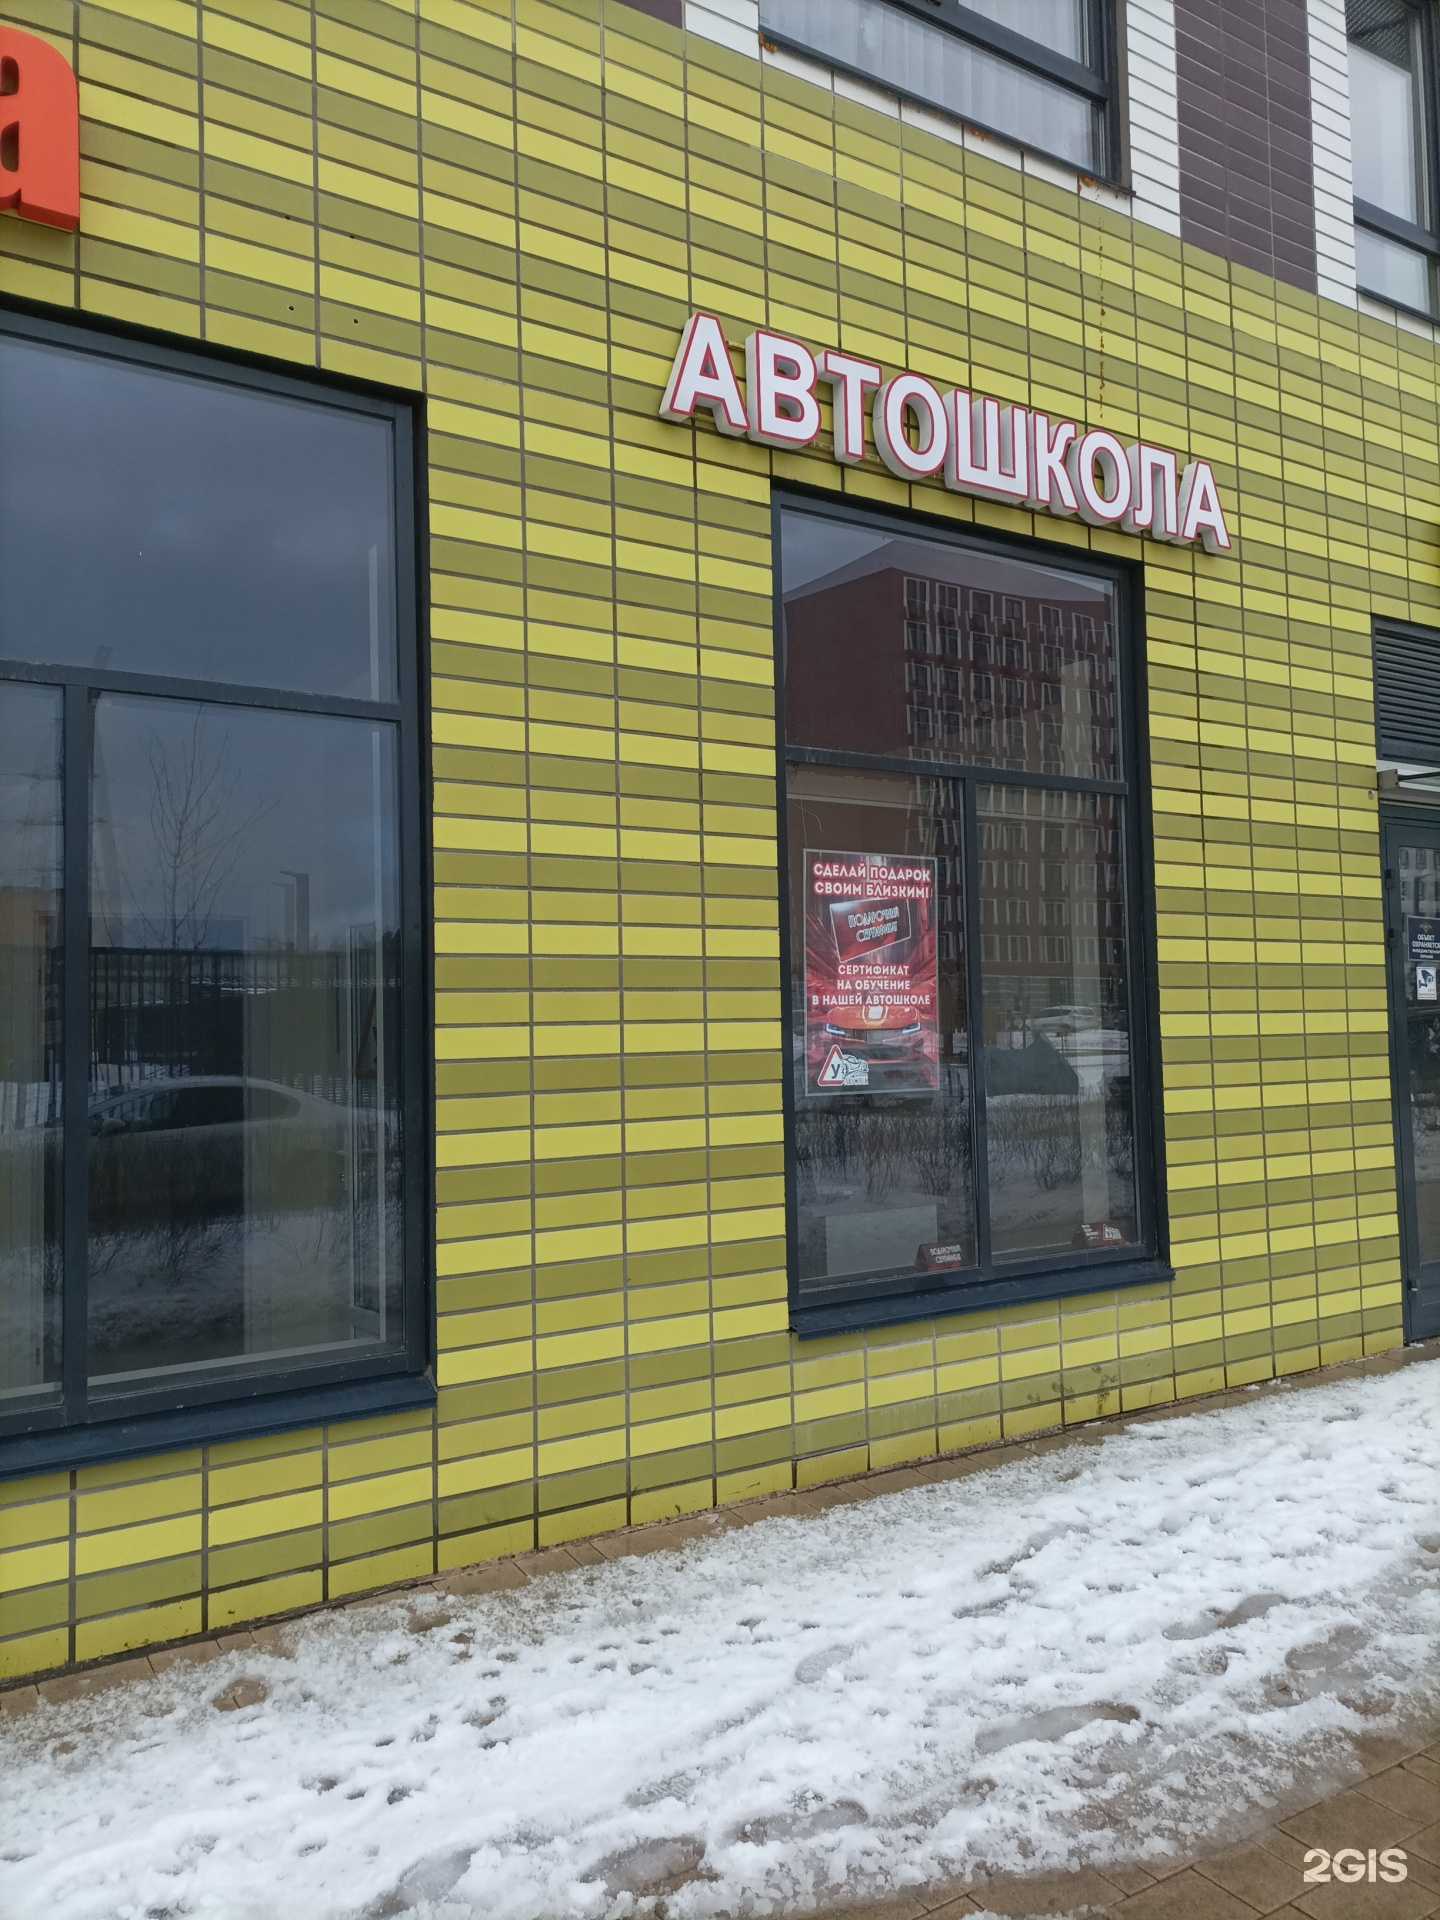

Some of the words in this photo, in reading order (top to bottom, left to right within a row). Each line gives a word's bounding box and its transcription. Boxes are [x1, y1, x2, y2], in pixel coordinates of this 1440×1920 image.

[659, 311, 1231, 553] АВТОШКОЛА
[813, 863, 866, 878] СДЕЛАЙ
[870, 866, 931, 881] ПОДАРОК
[815, 882, 862, 895] СВОИМ
[838, 964, 910, 976] СЕРТИФИКАТ
[837, 979, 852, 990] НА
[855, 979, 911, 990] ОБУЧЕНИЕ
[812, 995, 819, 1005] В
[822, 993, 863, 1005] НАШЕЙ
[865, 994, 931, 1005] АВТОШКОЛЕ
